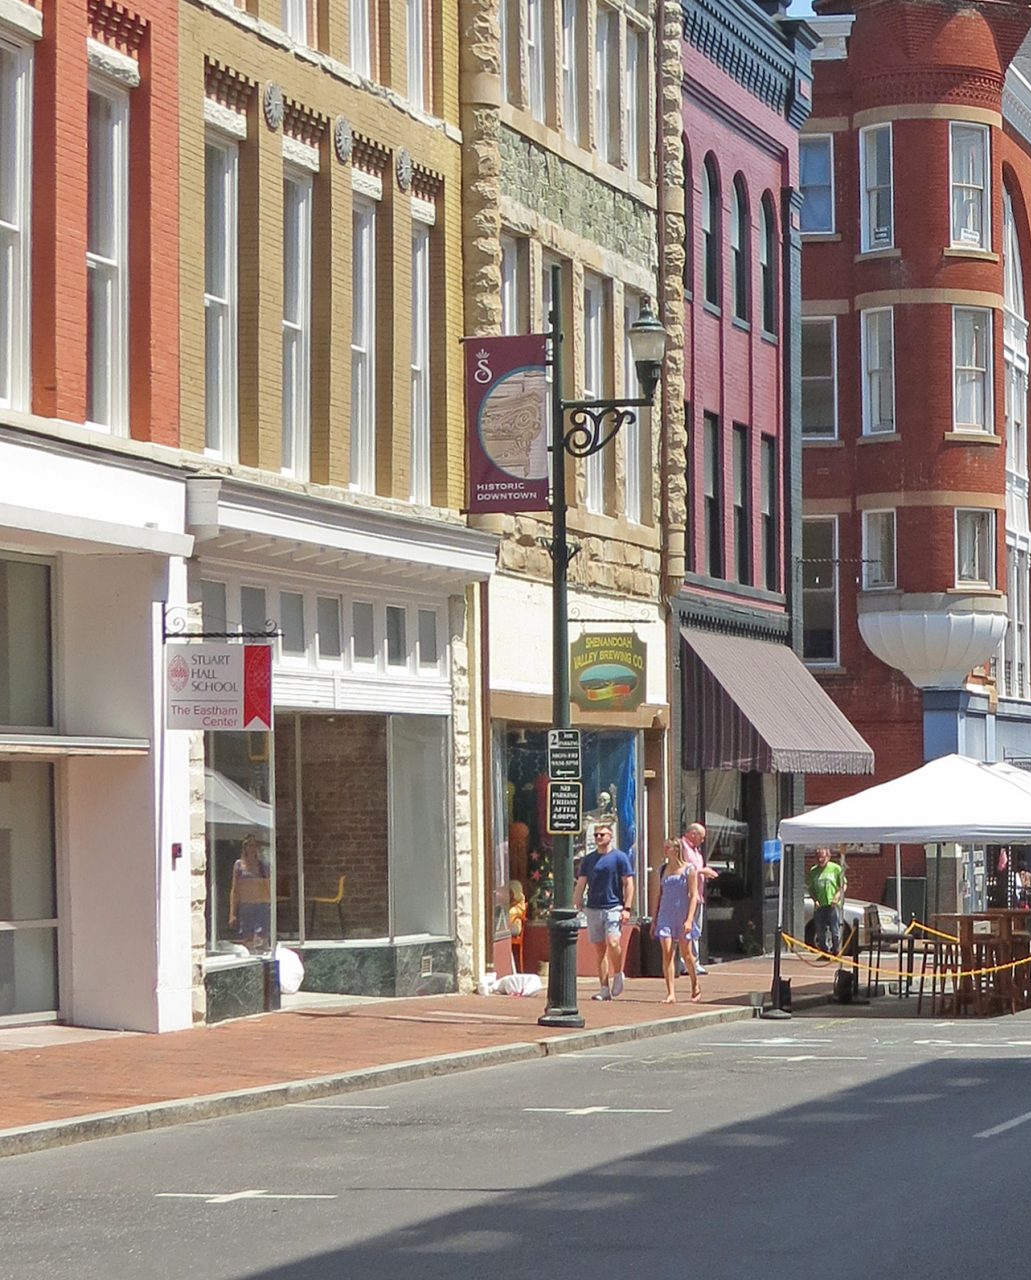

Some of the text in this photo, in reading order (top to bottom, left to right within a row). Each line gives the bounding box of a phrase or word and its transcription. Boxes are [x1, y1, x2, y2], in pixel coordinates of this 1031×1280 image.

[476, 482, 525, 491] HISTORIC
[476, 491, 537, 501] DOWNTOWN
[585, 636, 633, 649] SHENANDOAH
[191, 654, 231, 665] STUART
[573, 650, 599, 670] VALLEY
[599, 650, 632, 664] BREWING
[191, 669, 217, 679] HALL
[191, 681, 239, 693] SCHOOL
[171, 705, 238, 716] The Eastham
[202, 716, 238, 727] Center
[550, 733, 558, 746] 2
